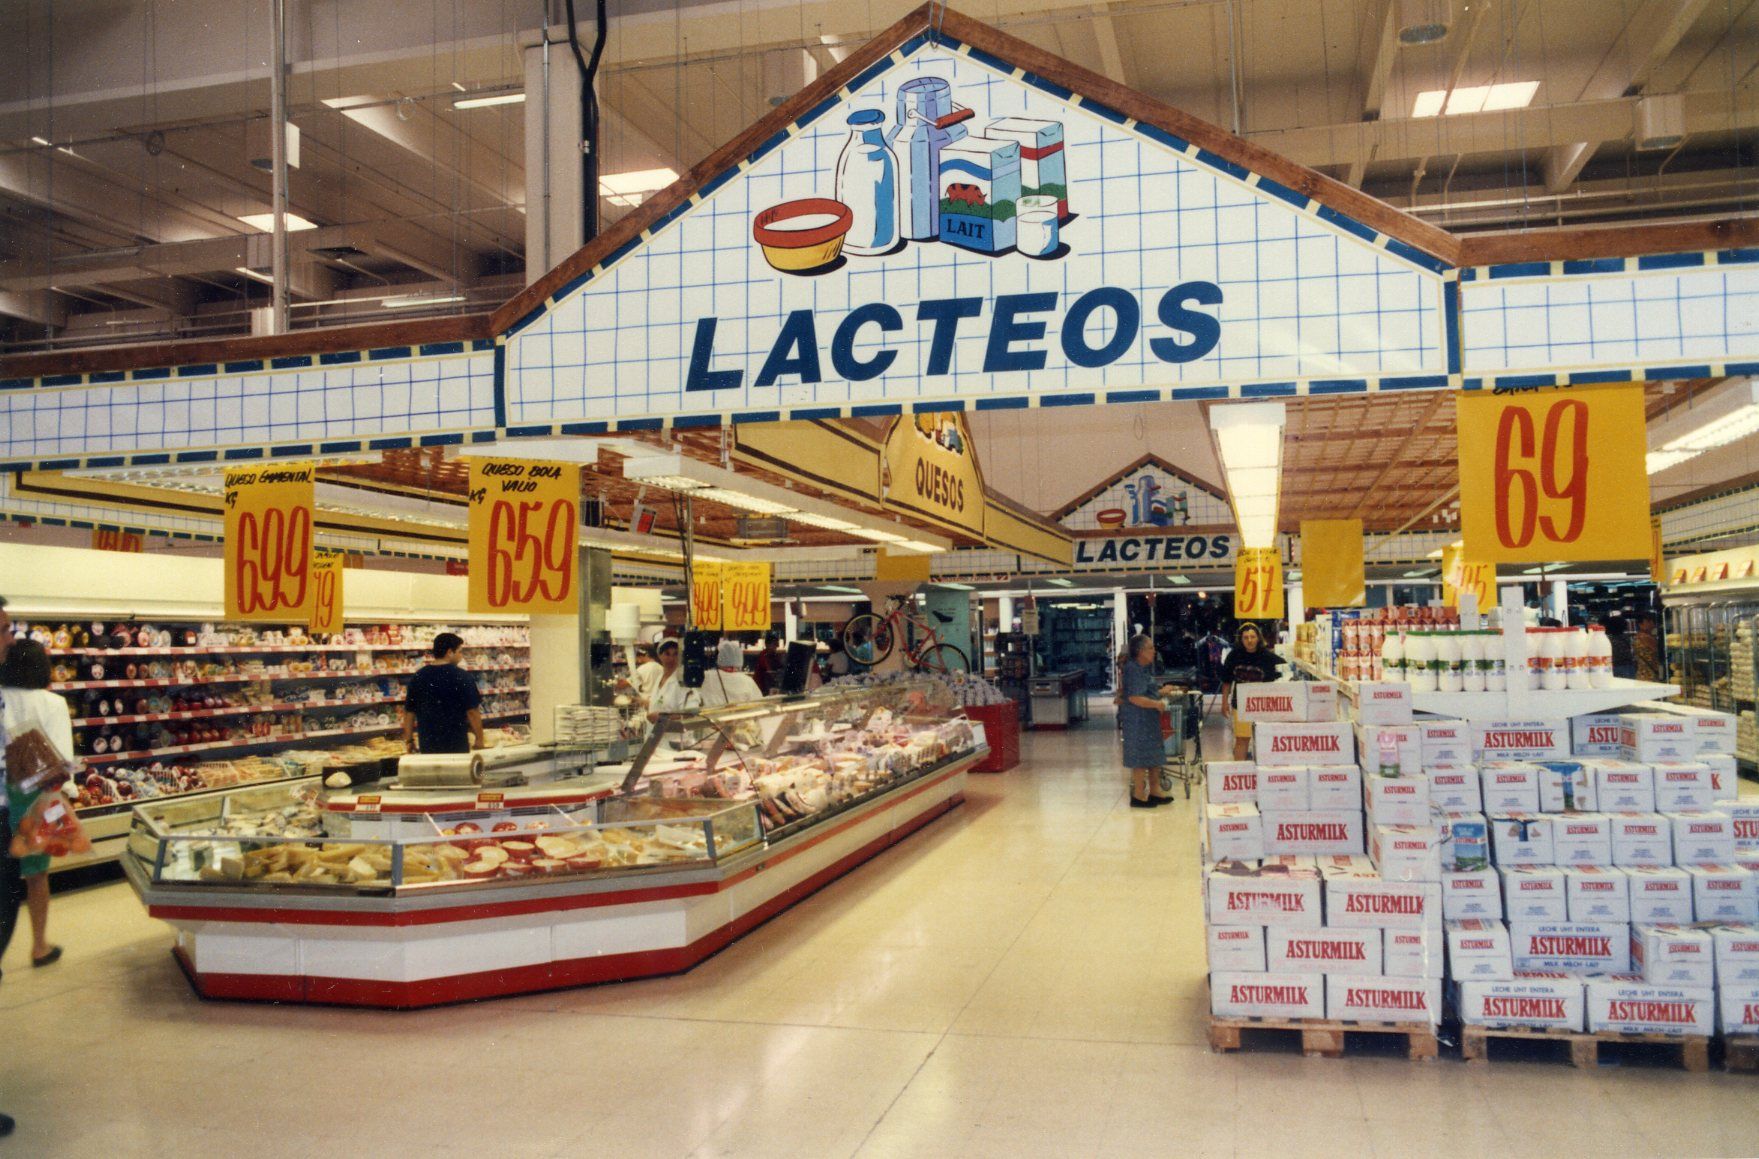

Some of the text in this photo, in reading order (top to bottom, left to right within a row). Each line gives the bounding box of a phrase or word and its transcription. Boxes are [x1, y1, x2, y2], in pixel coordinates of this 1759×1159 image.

[946, 218, 986, 240] LAIT
[685, 280, 1224, 392] LACTEOS
[225, 472, 256, 488] QUESO
[482, 462, 562, 480] QUESO BOLA
[1494, 398, 1590, 549] 69
[915, 456, 964, 513] QUESOS
[487, 498, 575, 608] 659
[1076, 535, 1230, 563] LACTEOS
[237, 506, 311, 614] 699
[1239, 565, 1275, 613] 57
[1245, 696, 1294, 713] ASTURMILK
[1271, 735, 1341, 752] ASTURMILK
[1484, 731, 1555, 749] ASTURMILK
[1384, 786, 1416, 794] ASTURMILK
[1219, 823, 1249, 832] ASTURMILK
[1277, 823, 1348, 841] ASTURMILK
[1393, 841, 1428, 850] ASTURMILK
[1218, 930, 1249, 940] ASTURMILK
[1460, 939, 1495, 950] ASTURMILK
[1285, 940, 1367, 960] ASTURMILK
[1529, 936, 1612, 956] ASTURMILK
[1230, 984, 1309, 1005] ASTURMILK
[1345, 988, 1427, 1010] ASTURMILK
[1482, 997, 1567, 1018] ASTURMILK
[1607, 1001, 1697, 1024] ASTURMILK
